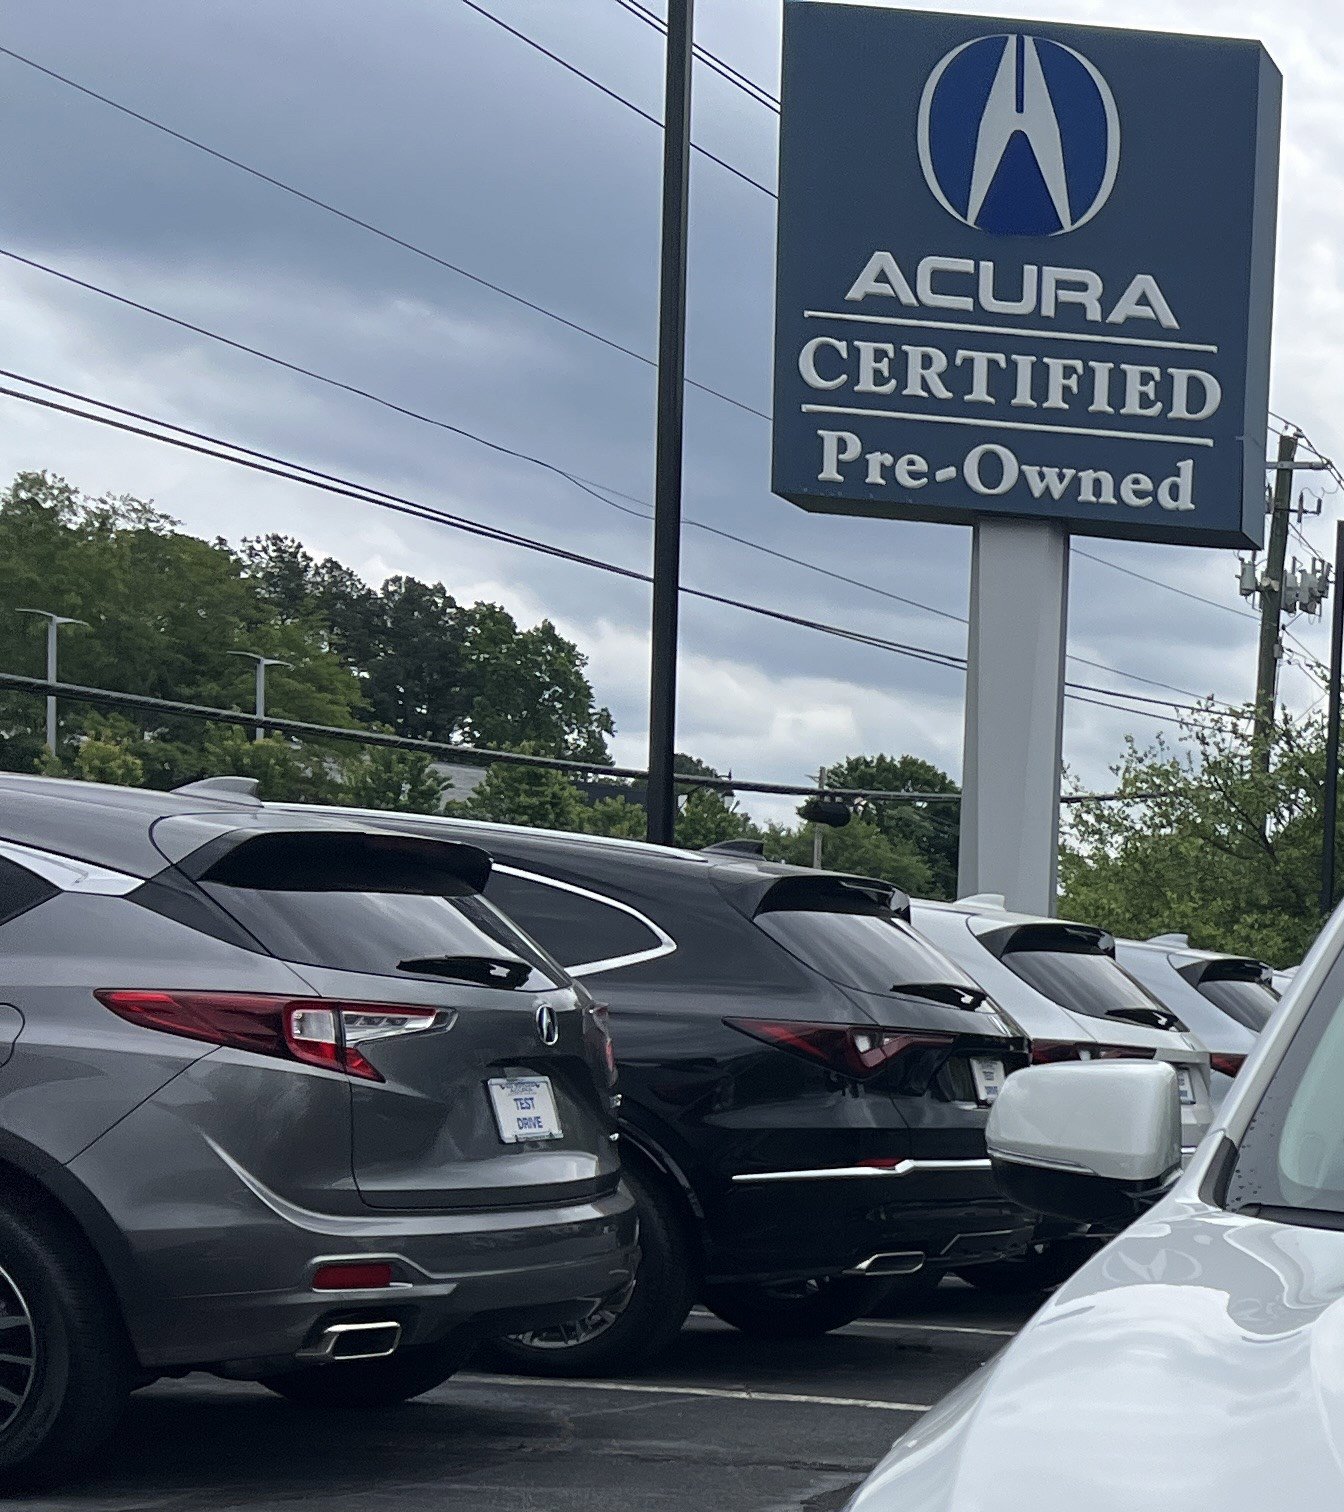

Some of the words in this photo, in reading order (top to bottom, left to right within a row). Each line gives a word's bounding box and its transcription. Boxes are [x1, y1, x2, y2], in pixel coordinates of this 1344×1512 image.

[844, 250, 1181, 330] ACURA
[798, 337, 1223, 422] CERTIFIED
[816, 429, 1196, 512] Pre-Owned
[513, 1096, 536, 1111] TEST
[516, 1115, 544, 1130] DRIVE
